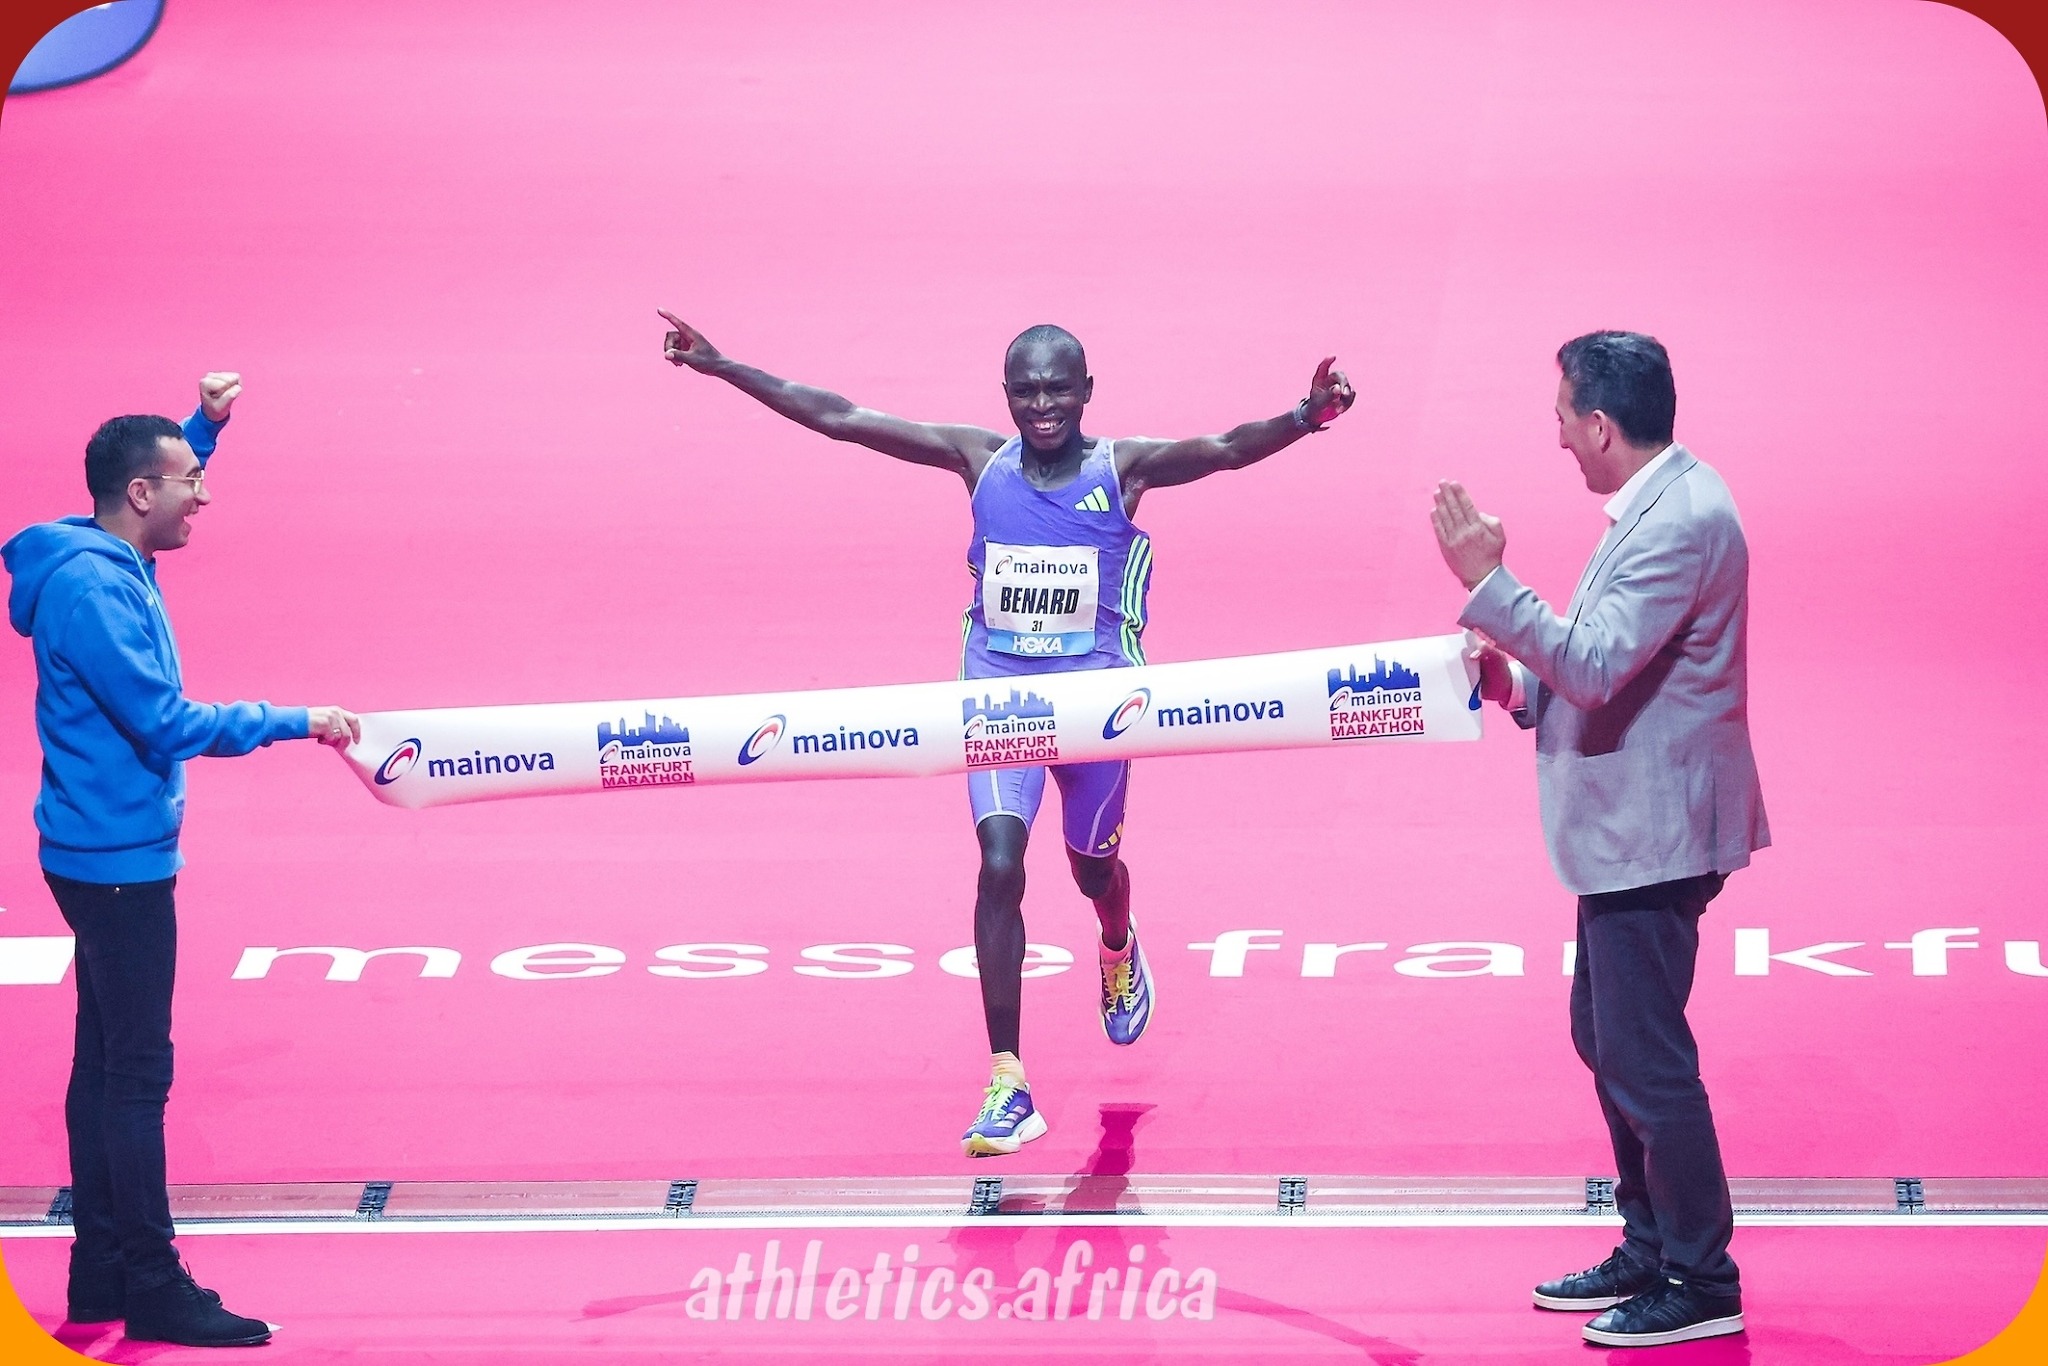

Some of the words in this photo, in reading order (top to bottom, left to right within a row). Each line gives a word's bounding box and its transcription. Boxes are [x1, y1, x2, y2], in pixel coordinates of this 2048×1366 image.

[1013, 559, 1088, 575] mainova
[1000, 586, 1080, 615] BENARD
[1031, 620, 1043, 632] 31
[1012, 635, 1064, 654] HOKA
[1351, 690, 1422, 706] mainova
[1158, 698, 1284, 727] mainova
[1330, 706, 1422, 724] FRANKFURT
[985, 719, 1056, 735] mainova
[1331, 719, 1424, 737] MARATHON
[793, 725, 919, 754] mainova
[964, 735, 1057, 752] FRANKFURT
[621, 745, 692, 760] mainova
[966, 747, 1059, 764] MARATHON
[428, 749, 555, 777] mainova
[600, 760, 692, 776] FRANKFURT
[602, 772, 695, 786] MARATHON
[230, 942, 1075, 982] messe
[1187, 926, 2048, 978] frakf
